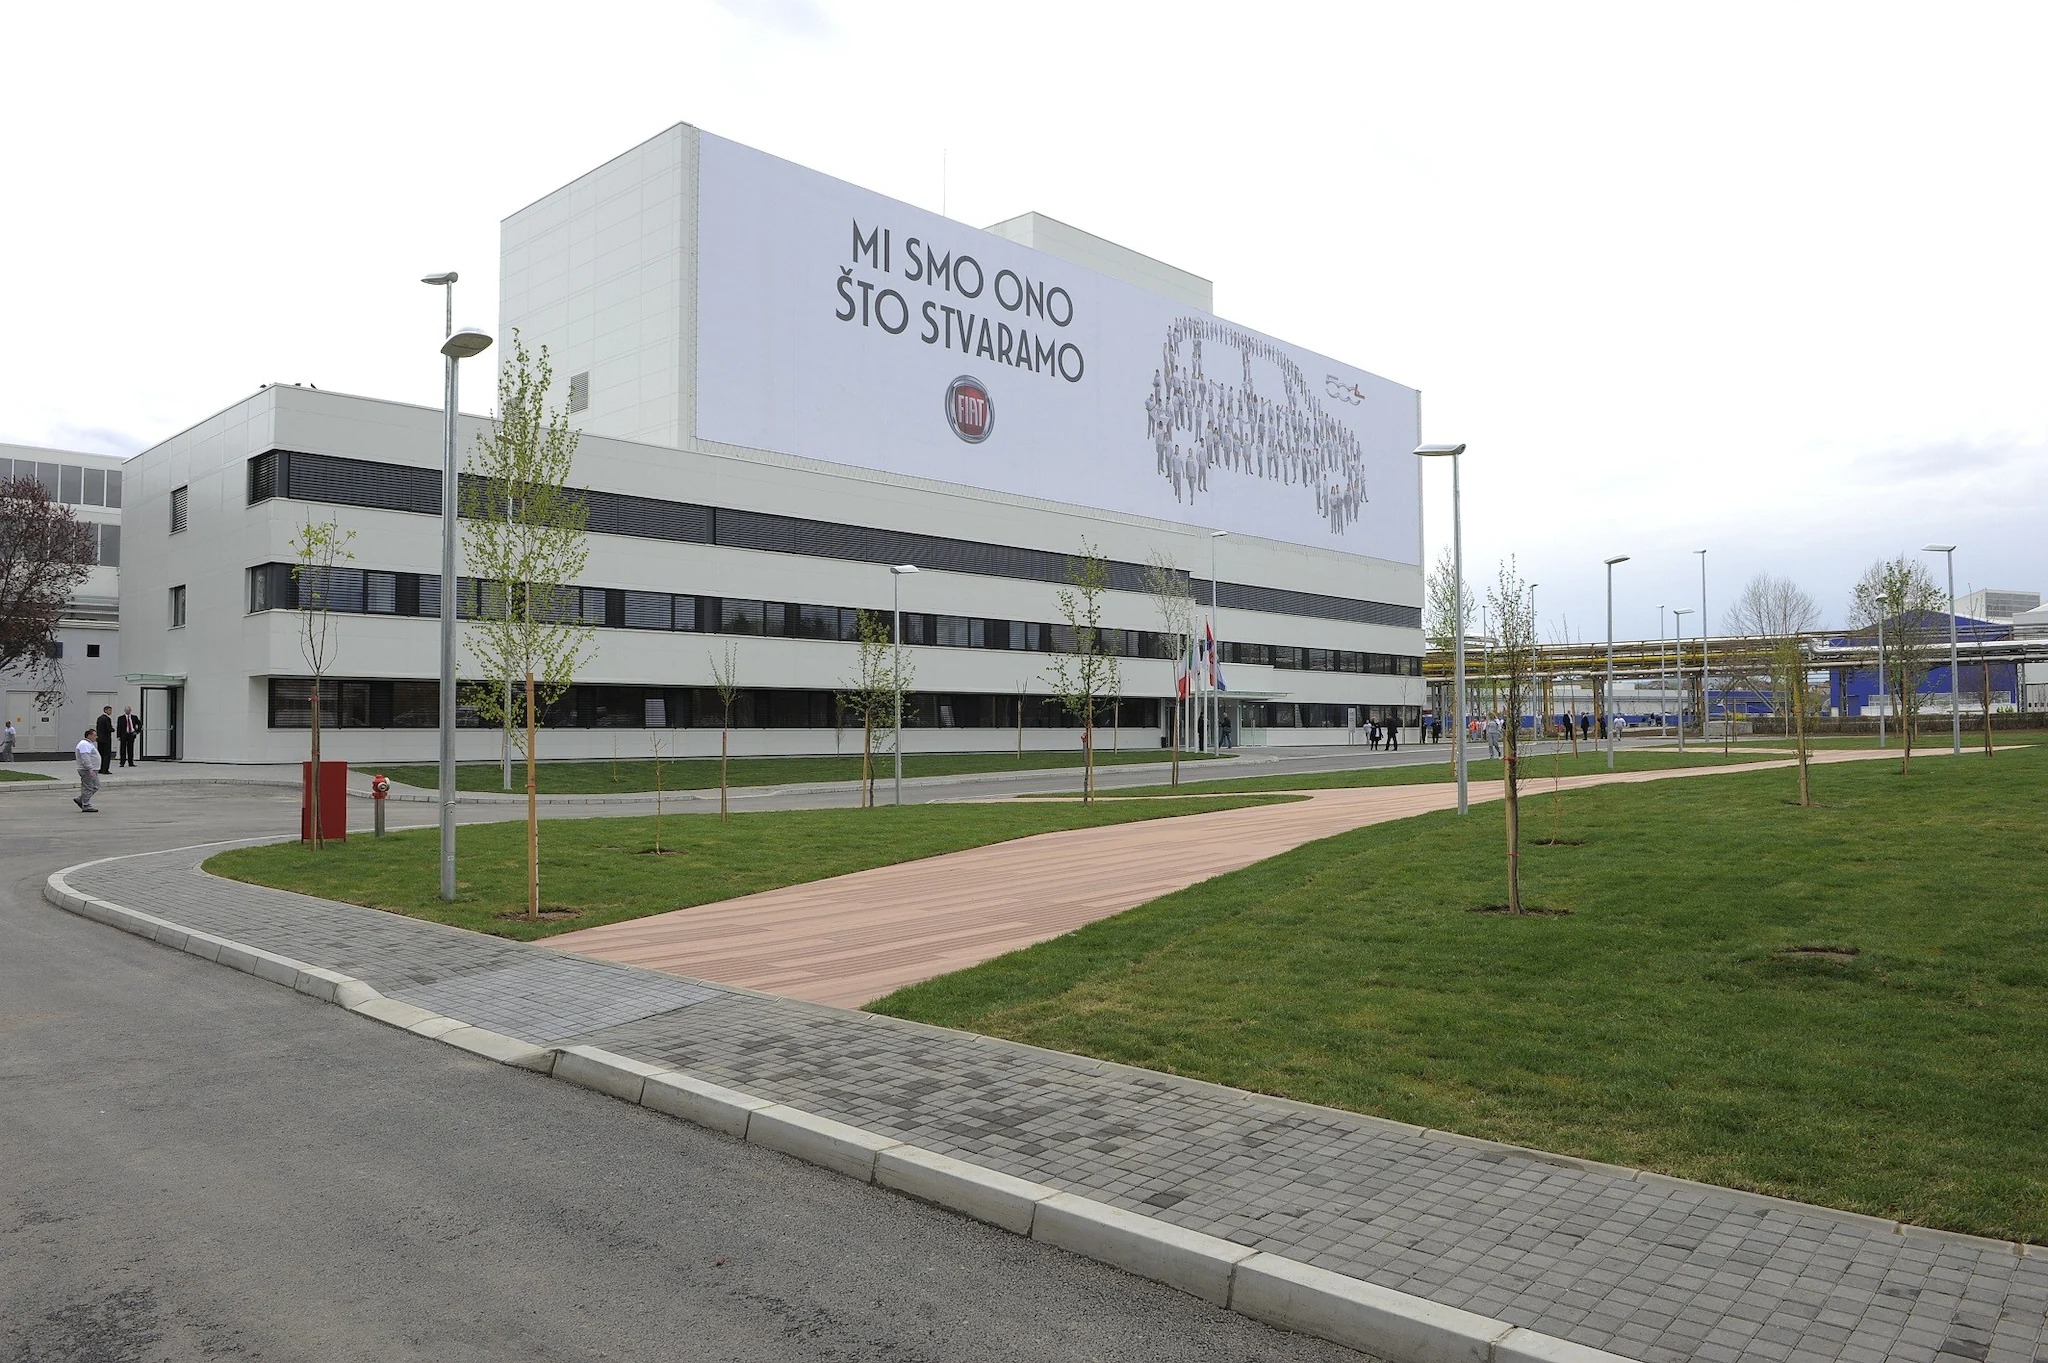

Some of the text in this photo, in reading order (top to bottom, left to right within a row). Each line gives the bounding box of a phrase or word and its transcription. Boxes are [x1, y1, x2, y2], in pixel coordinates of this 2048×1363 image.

[835, 265, 1085, 383] ŠTO STVARAMO
[852, 216, 1074, 328] MI SMO ONO
[957, 393, 985, 427] FIAT
